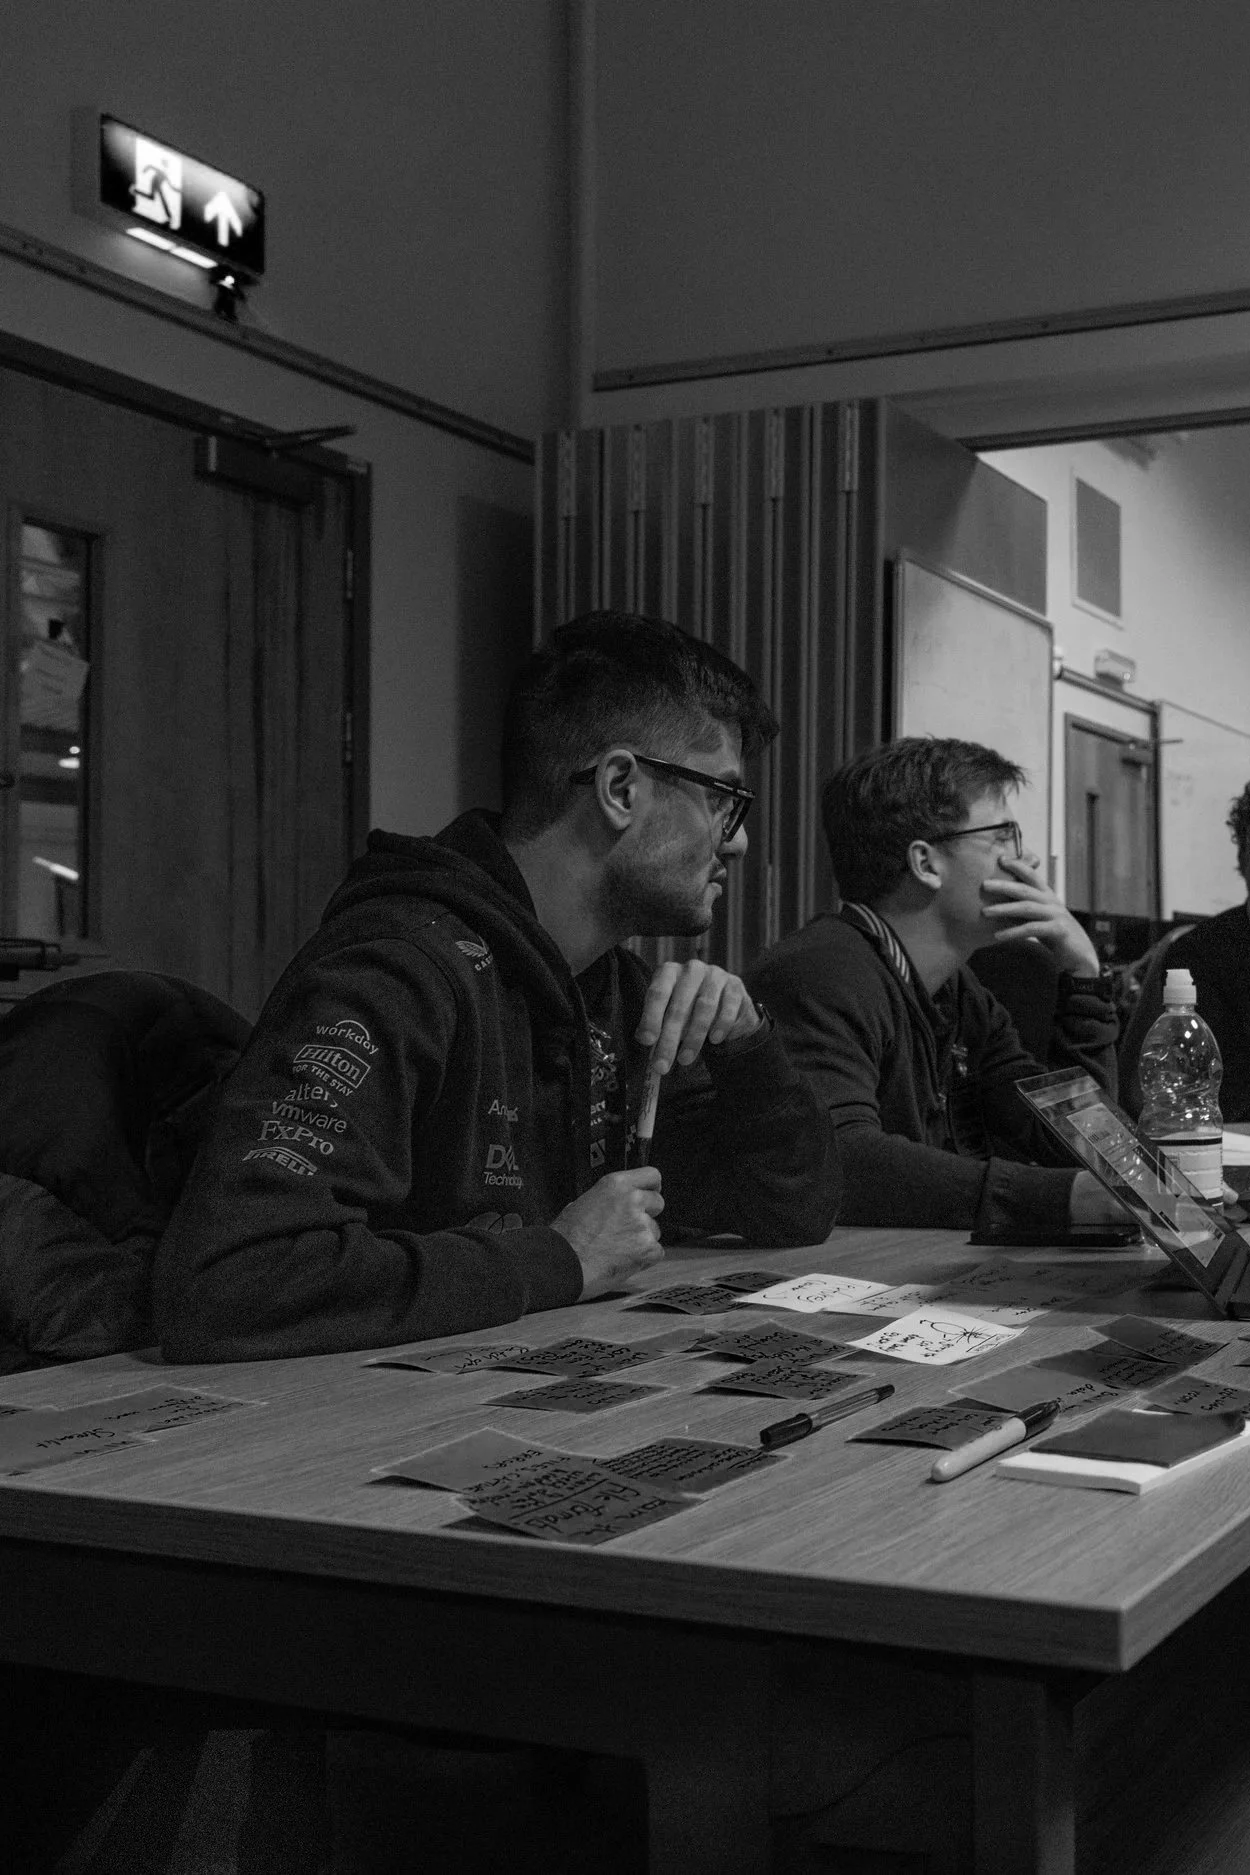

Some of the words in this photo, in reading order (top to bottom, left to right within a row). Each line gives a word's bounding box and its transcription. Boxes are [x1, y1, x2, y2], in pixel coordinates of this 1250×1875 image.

[315, 1023, 380, 1056] workday
[300, 1047, 362, 1081] Hilton
[311, 1066, 331, 1083] THE
[329, 1079, 355, 1097] STAY
[271, 1101, 347, 1134] vmware
[257, 1119, 335, 1156] FxPro
